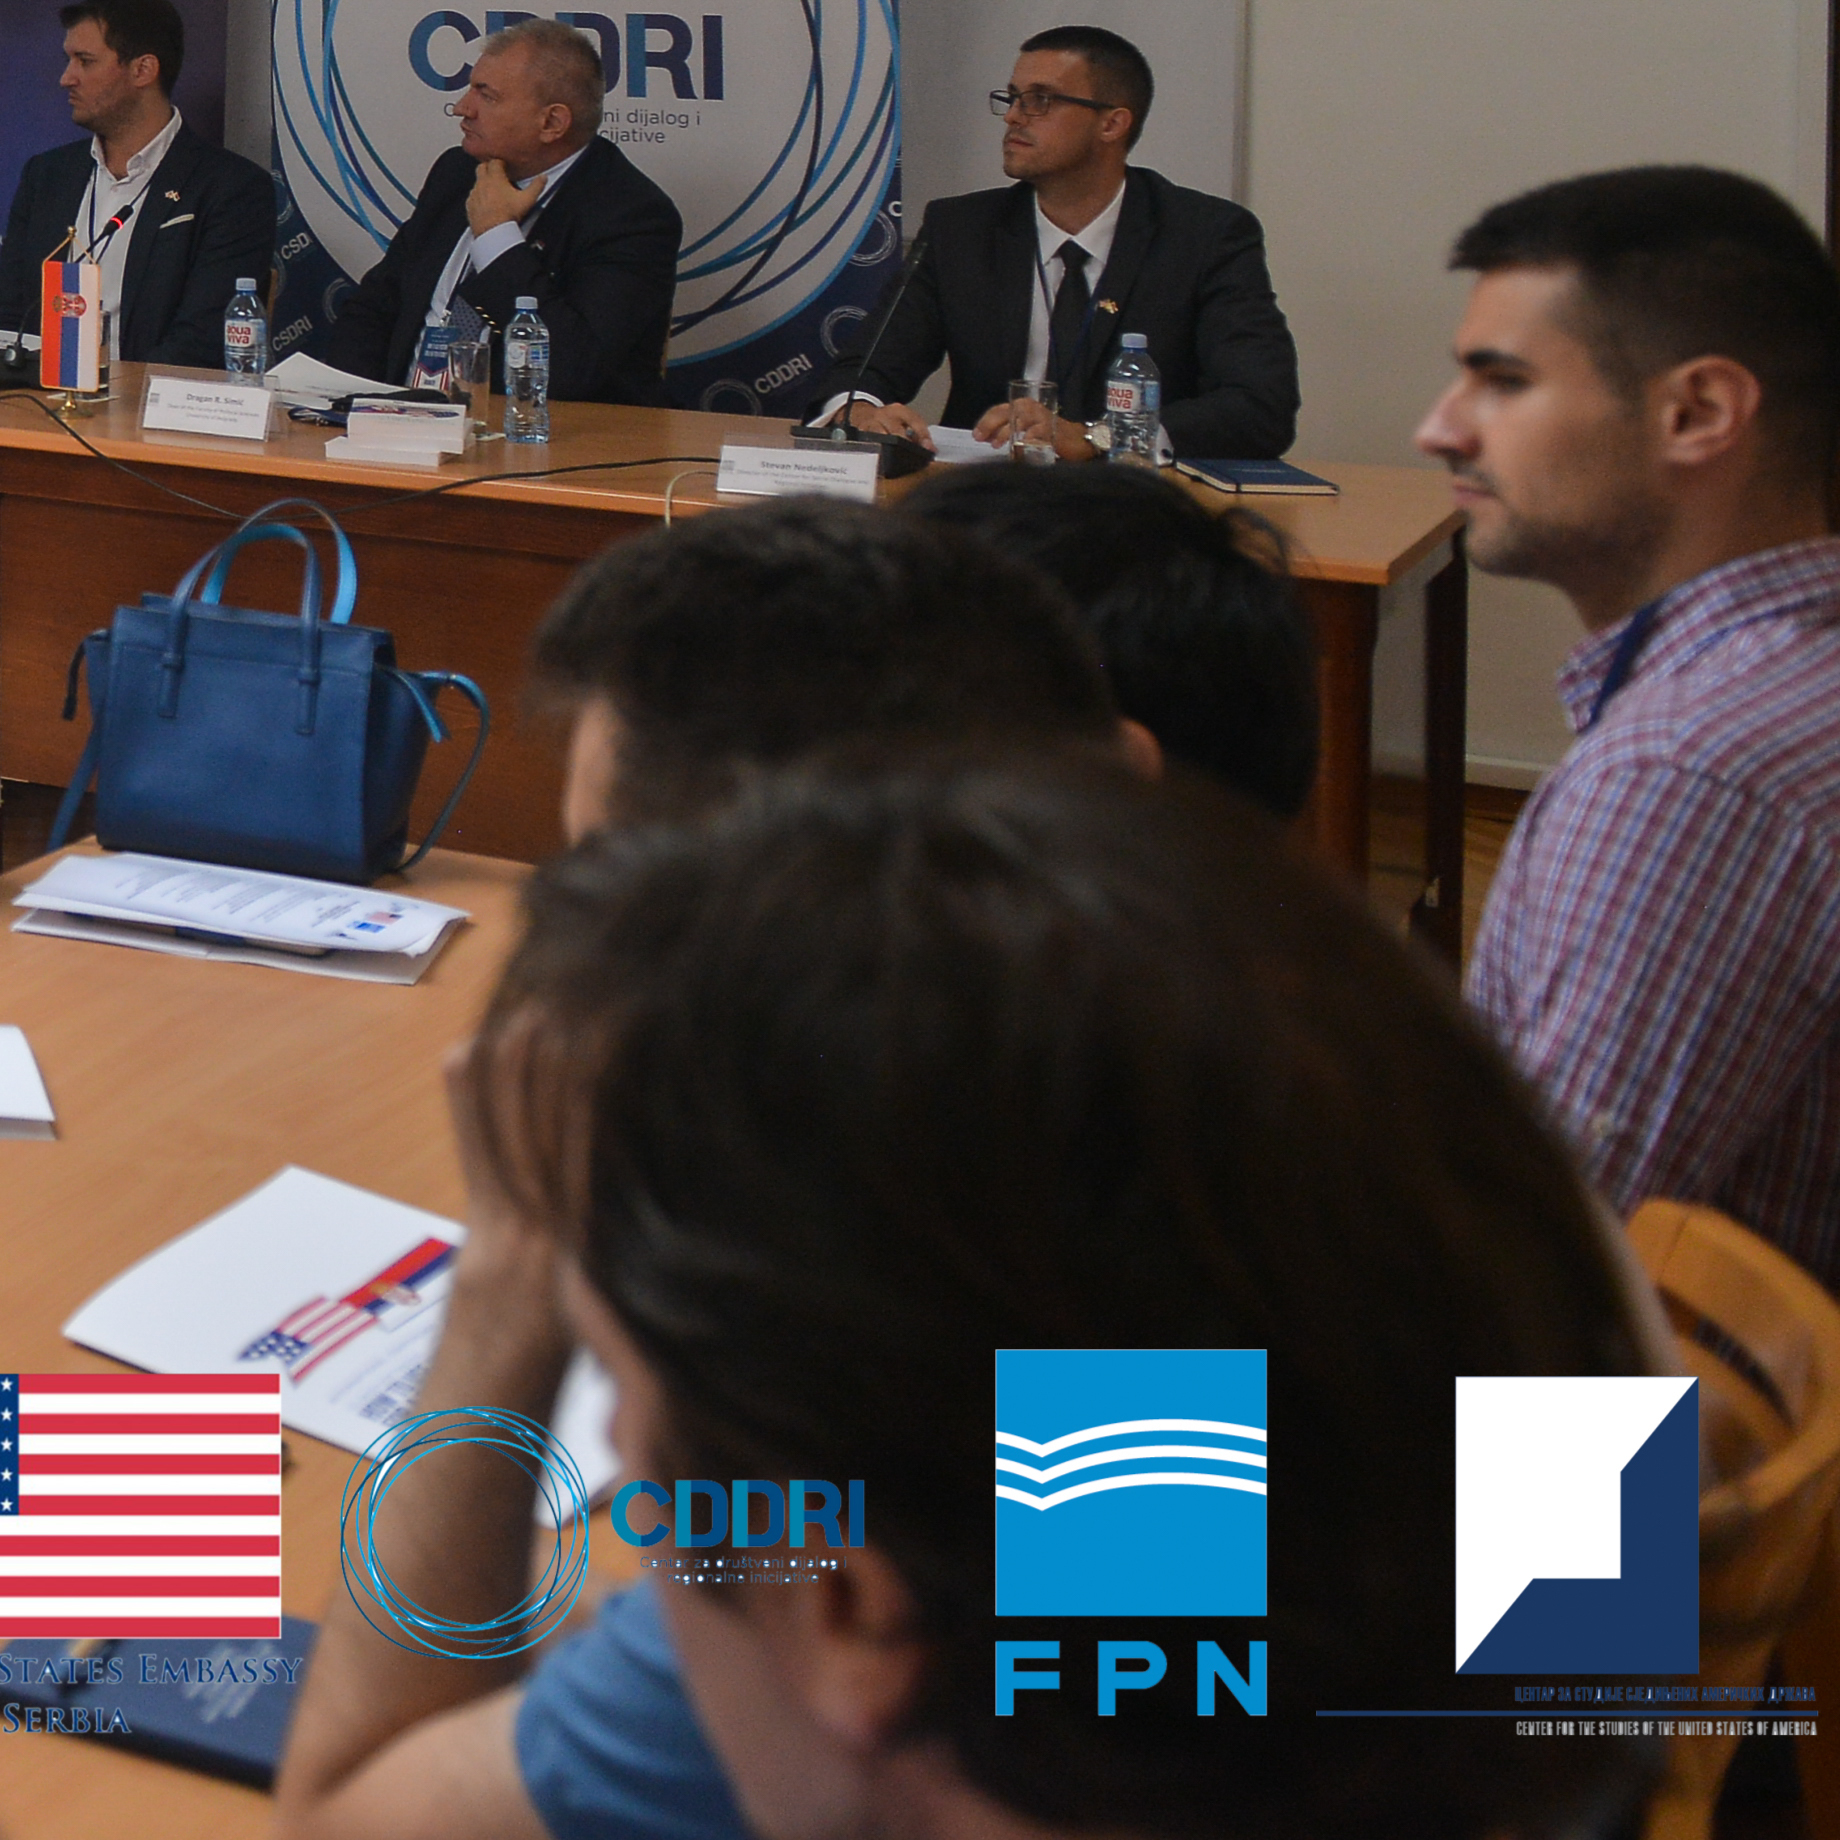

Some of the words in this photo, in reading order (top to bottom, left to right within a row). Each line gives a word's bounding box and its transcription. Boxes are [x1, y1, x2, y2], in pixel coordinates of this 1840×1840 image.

[627, 109, 689, 127] dijalog
[696, 111, 701, 126] i
[272, 315, 313, 352] CSDRI
[754, 353, 812, 395] CDDRI
